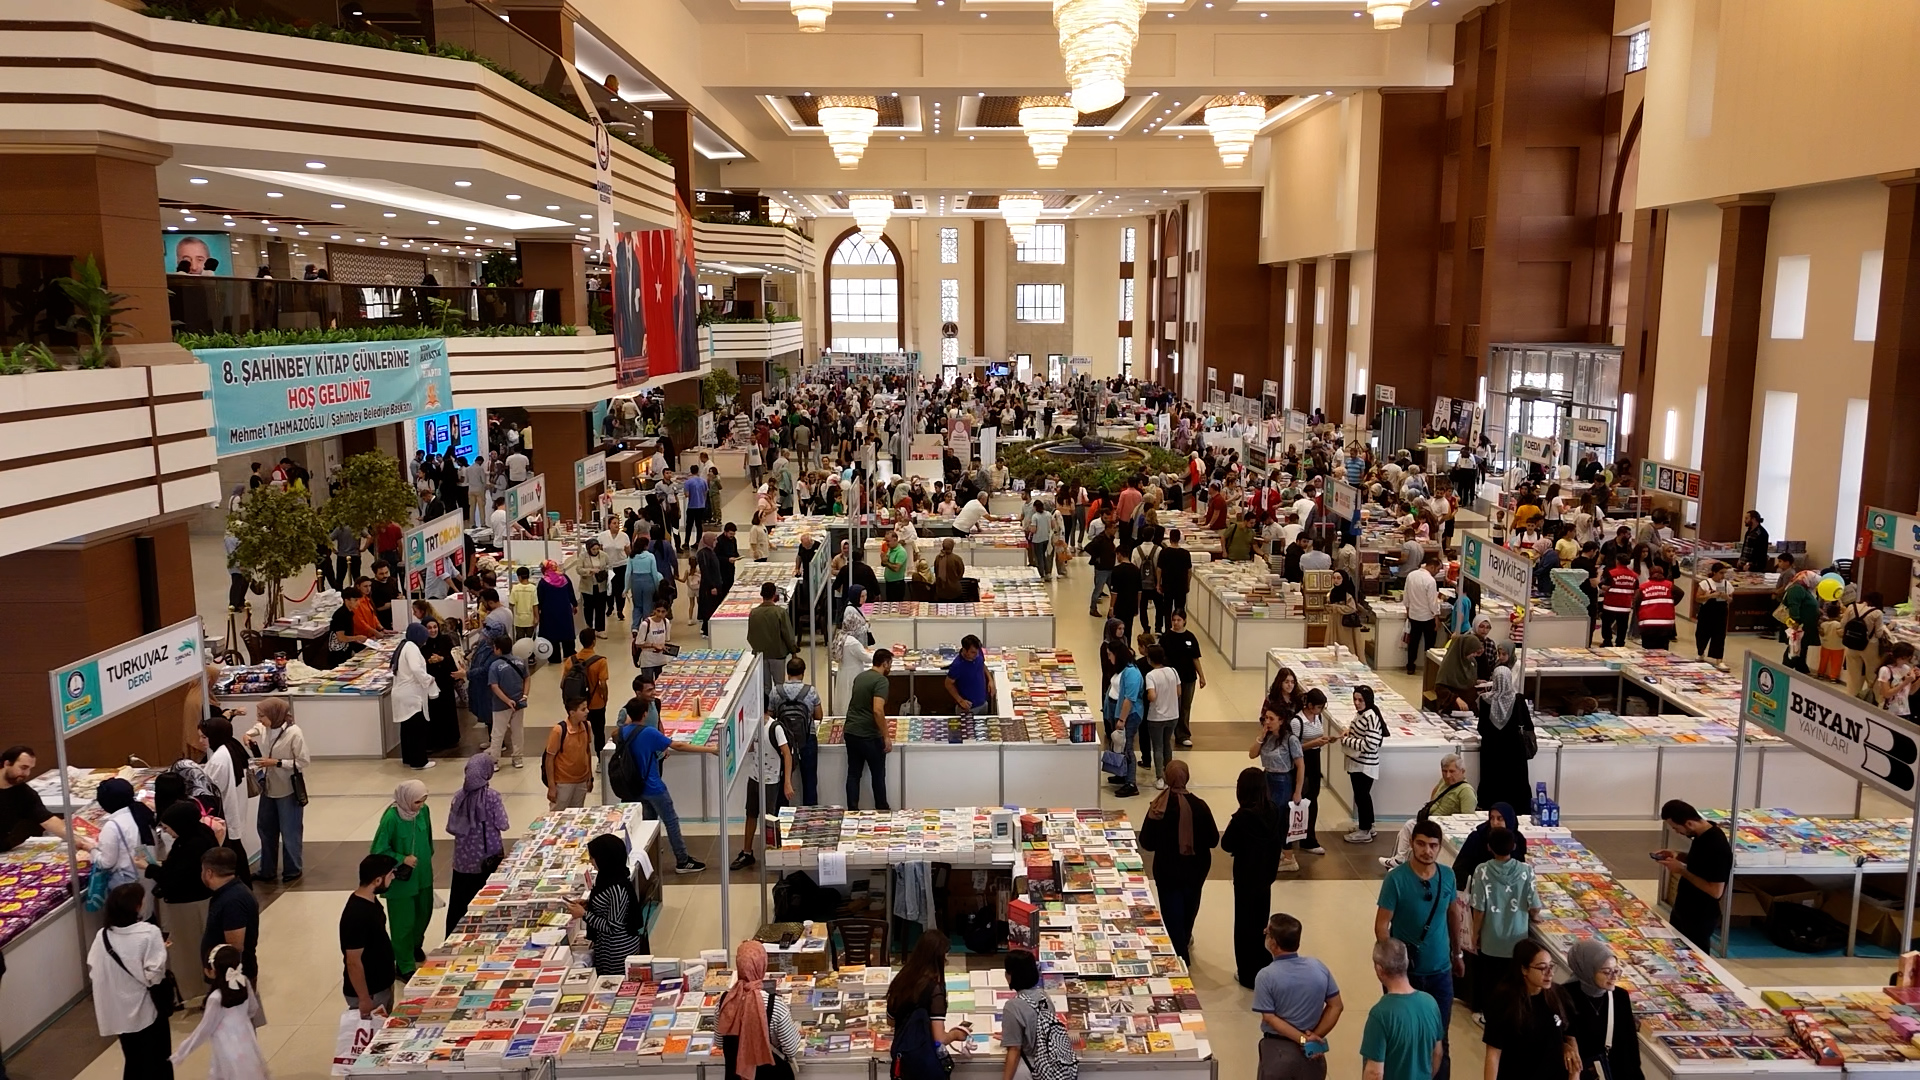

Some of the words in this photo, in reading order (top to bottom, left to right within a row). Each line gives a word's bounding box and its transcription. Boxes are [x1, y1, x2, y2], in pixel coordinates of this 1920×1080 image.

[223, 361, 238, 384] 8.
[242, 354, 312, 386] ŞAHİNBEY
[316, 350, 349, 375] KİTAP
[354, 348, 409, 372] GÜNLERİNE
[288, 387, 315, 410] HOŞ
[319, 379, 371, 406] GELDİNİZ
[230, 426, 266, 444] Mehmet
[268, 414, 325, 437] TAHMAZOĞLU
[331, 411, 362, 426] Şahinbey
[363, 405, 390, 420] Belediye
[390, 402, 413, 418] Başkanı
[425, 533, 439, 553] TRT
[1488, 548, 1527, 588] hayykitap
[106, 645, 169, 683] TURKUVAZ
[128, 667, 153, 690] DERGİ
[1790, 691, 1864, 744] BEYAN
[1799, 717, 1849, 755] YAYINLARI
